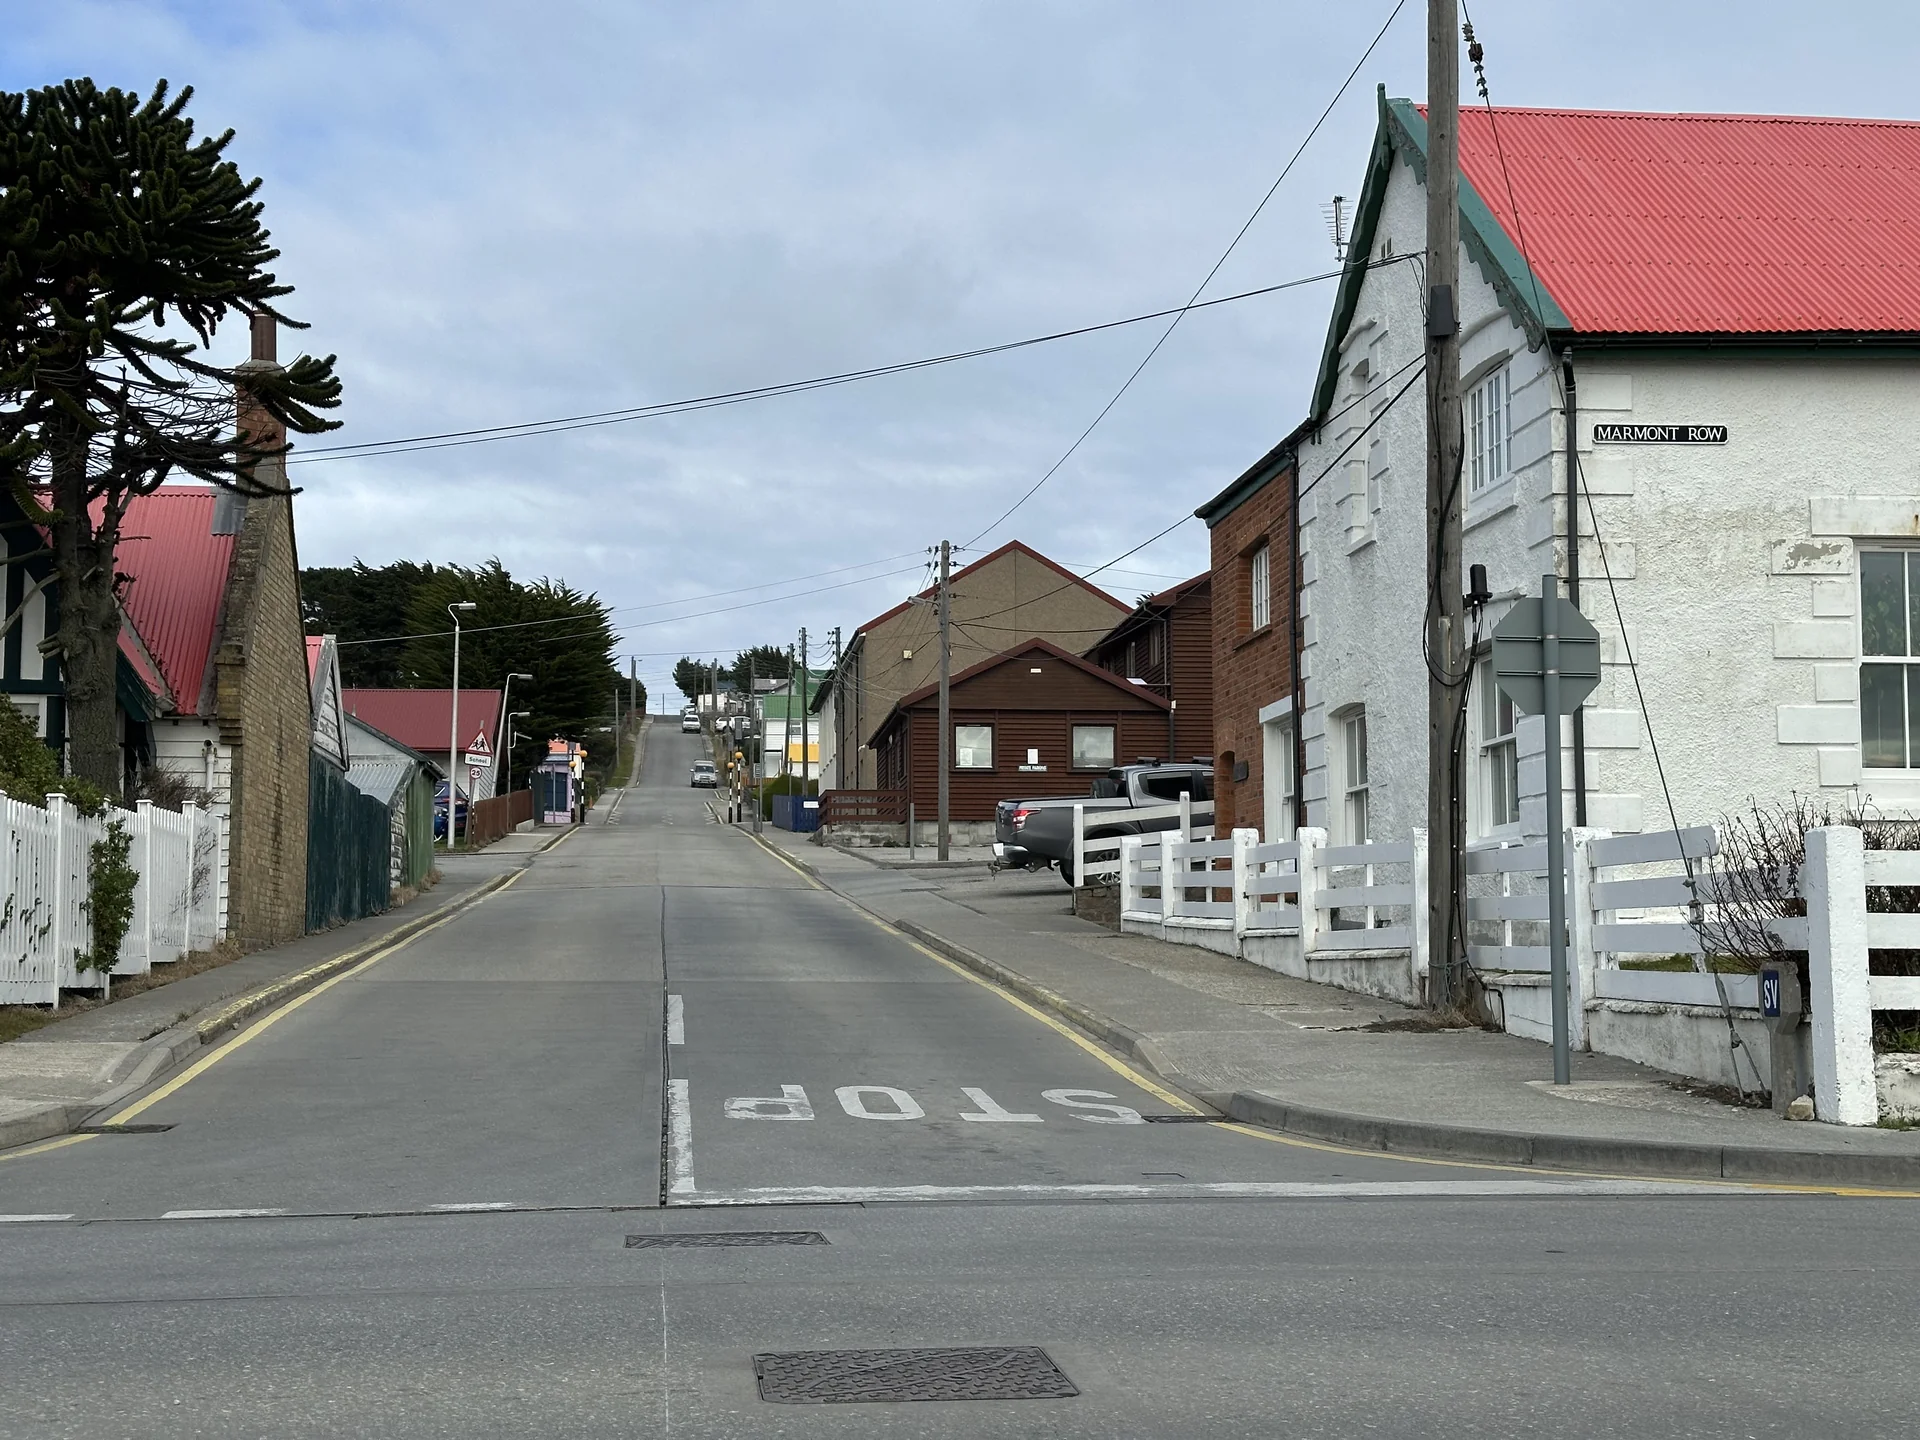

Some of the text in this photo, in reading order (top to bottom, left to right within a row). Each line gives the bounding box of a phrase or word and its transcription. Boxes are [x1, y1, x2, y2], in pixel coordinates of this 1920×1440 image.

[1597, 426, 1724, 441] MARMONT ROW
[469, 756, 488, 764] School
[1763, 979, 1778, 1009] SV
[723, 1084, 1145, 1125] STOP
